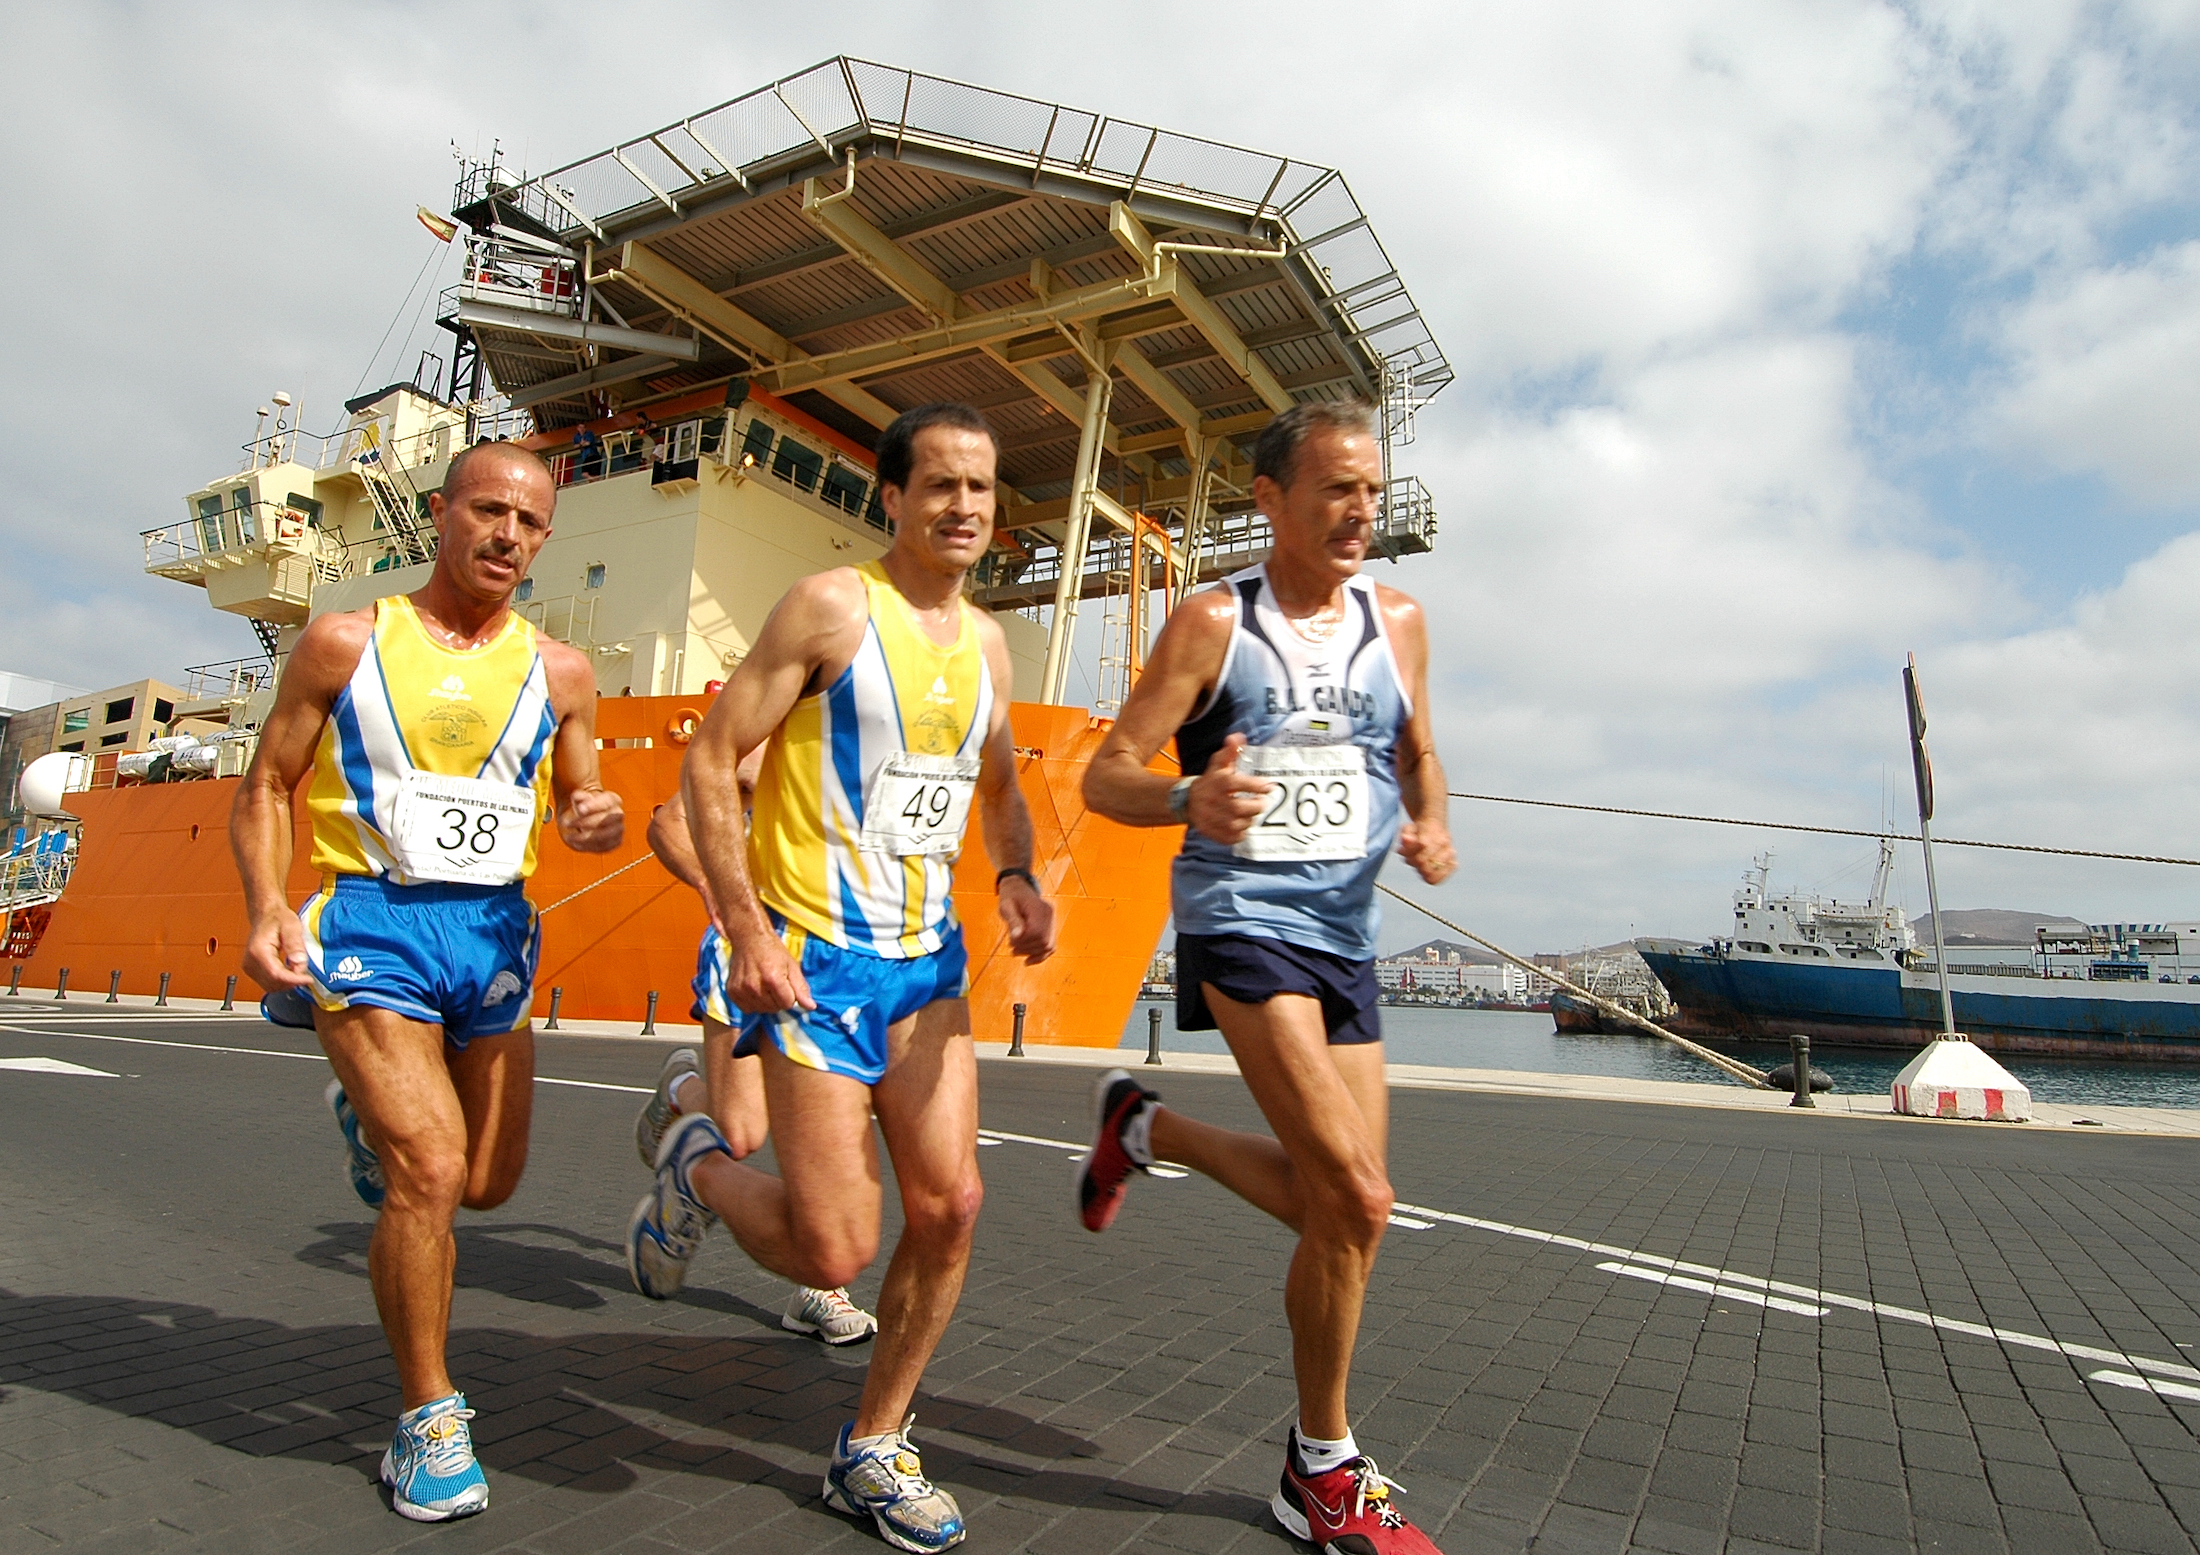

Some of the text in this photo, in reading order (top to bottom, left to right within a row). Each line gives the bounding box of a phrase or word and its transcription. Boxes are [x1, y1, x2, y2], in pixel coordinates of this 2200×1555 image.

[415, 791, 455, 803] FUNDACIÓN
[458, 798, 488, 809] PUERTOS
[489, 802, 497, 810] DE
[498, 803, 508, 812] LAS
[901, 785, 952, 828] 49
[1260, 781, 1352, 828] 263
[436, 808, 499, 854] 38
